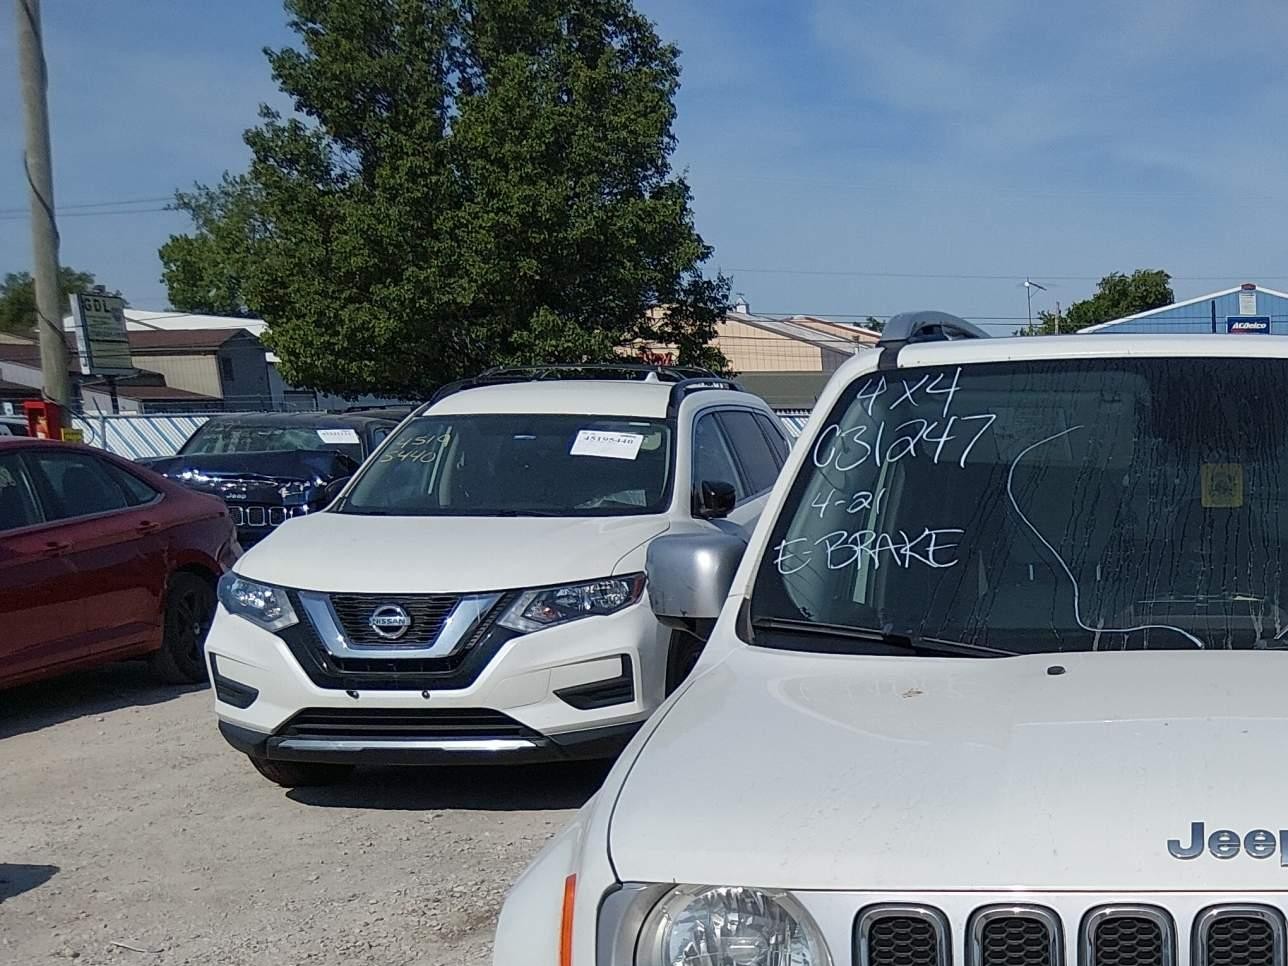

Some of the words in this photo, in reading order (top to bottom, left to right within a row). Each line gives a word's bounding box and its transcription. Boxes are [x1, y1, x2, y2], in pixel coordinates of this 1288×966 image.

[84, 298, 111, 313] GDL
[1232, 321, 1267, 329] ACDelco
[813, 414, 996, 471] 031247
